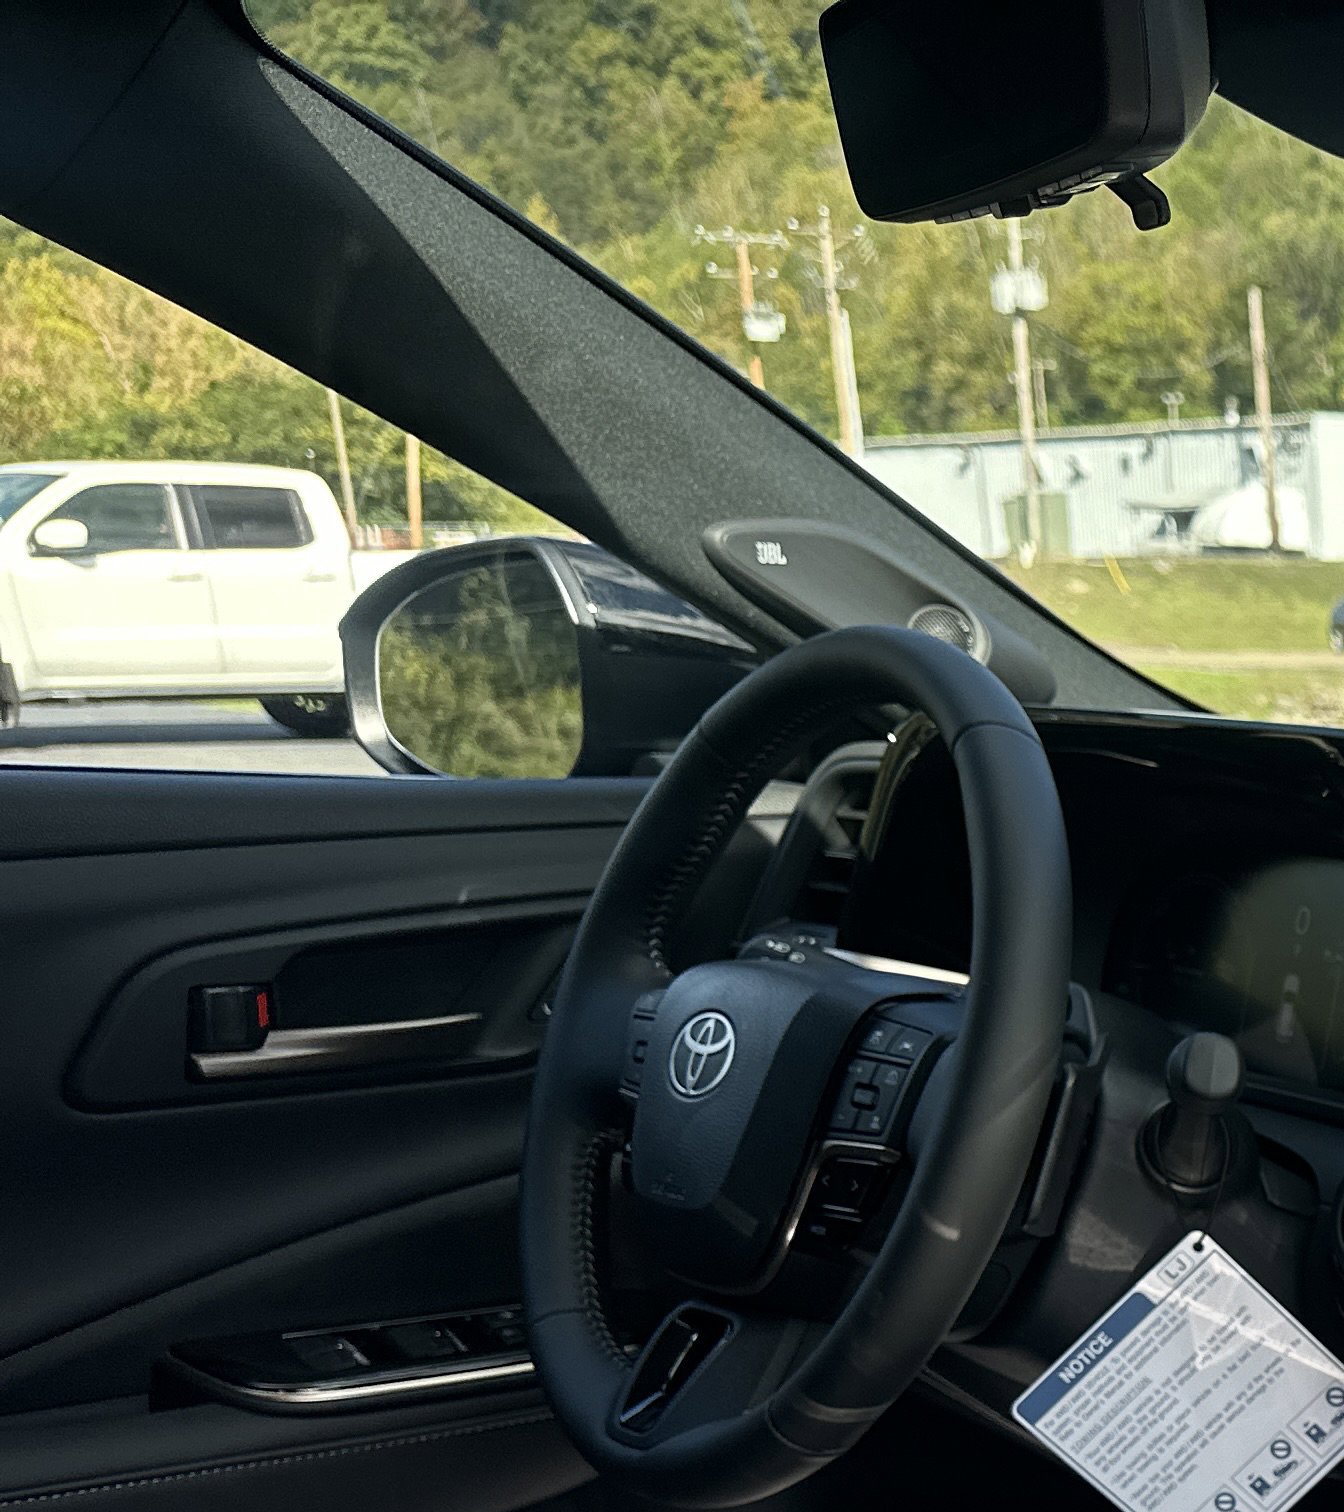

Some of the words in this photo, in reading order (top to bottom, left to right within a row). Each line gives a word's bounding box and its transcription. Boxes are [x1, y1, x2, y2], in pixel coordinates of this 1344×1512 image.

[755, 541, 787, 565] JBL
[1164, 1258, 1187, 1280] LJ
[1058, 1331, 1113, 1383] NOTICE
